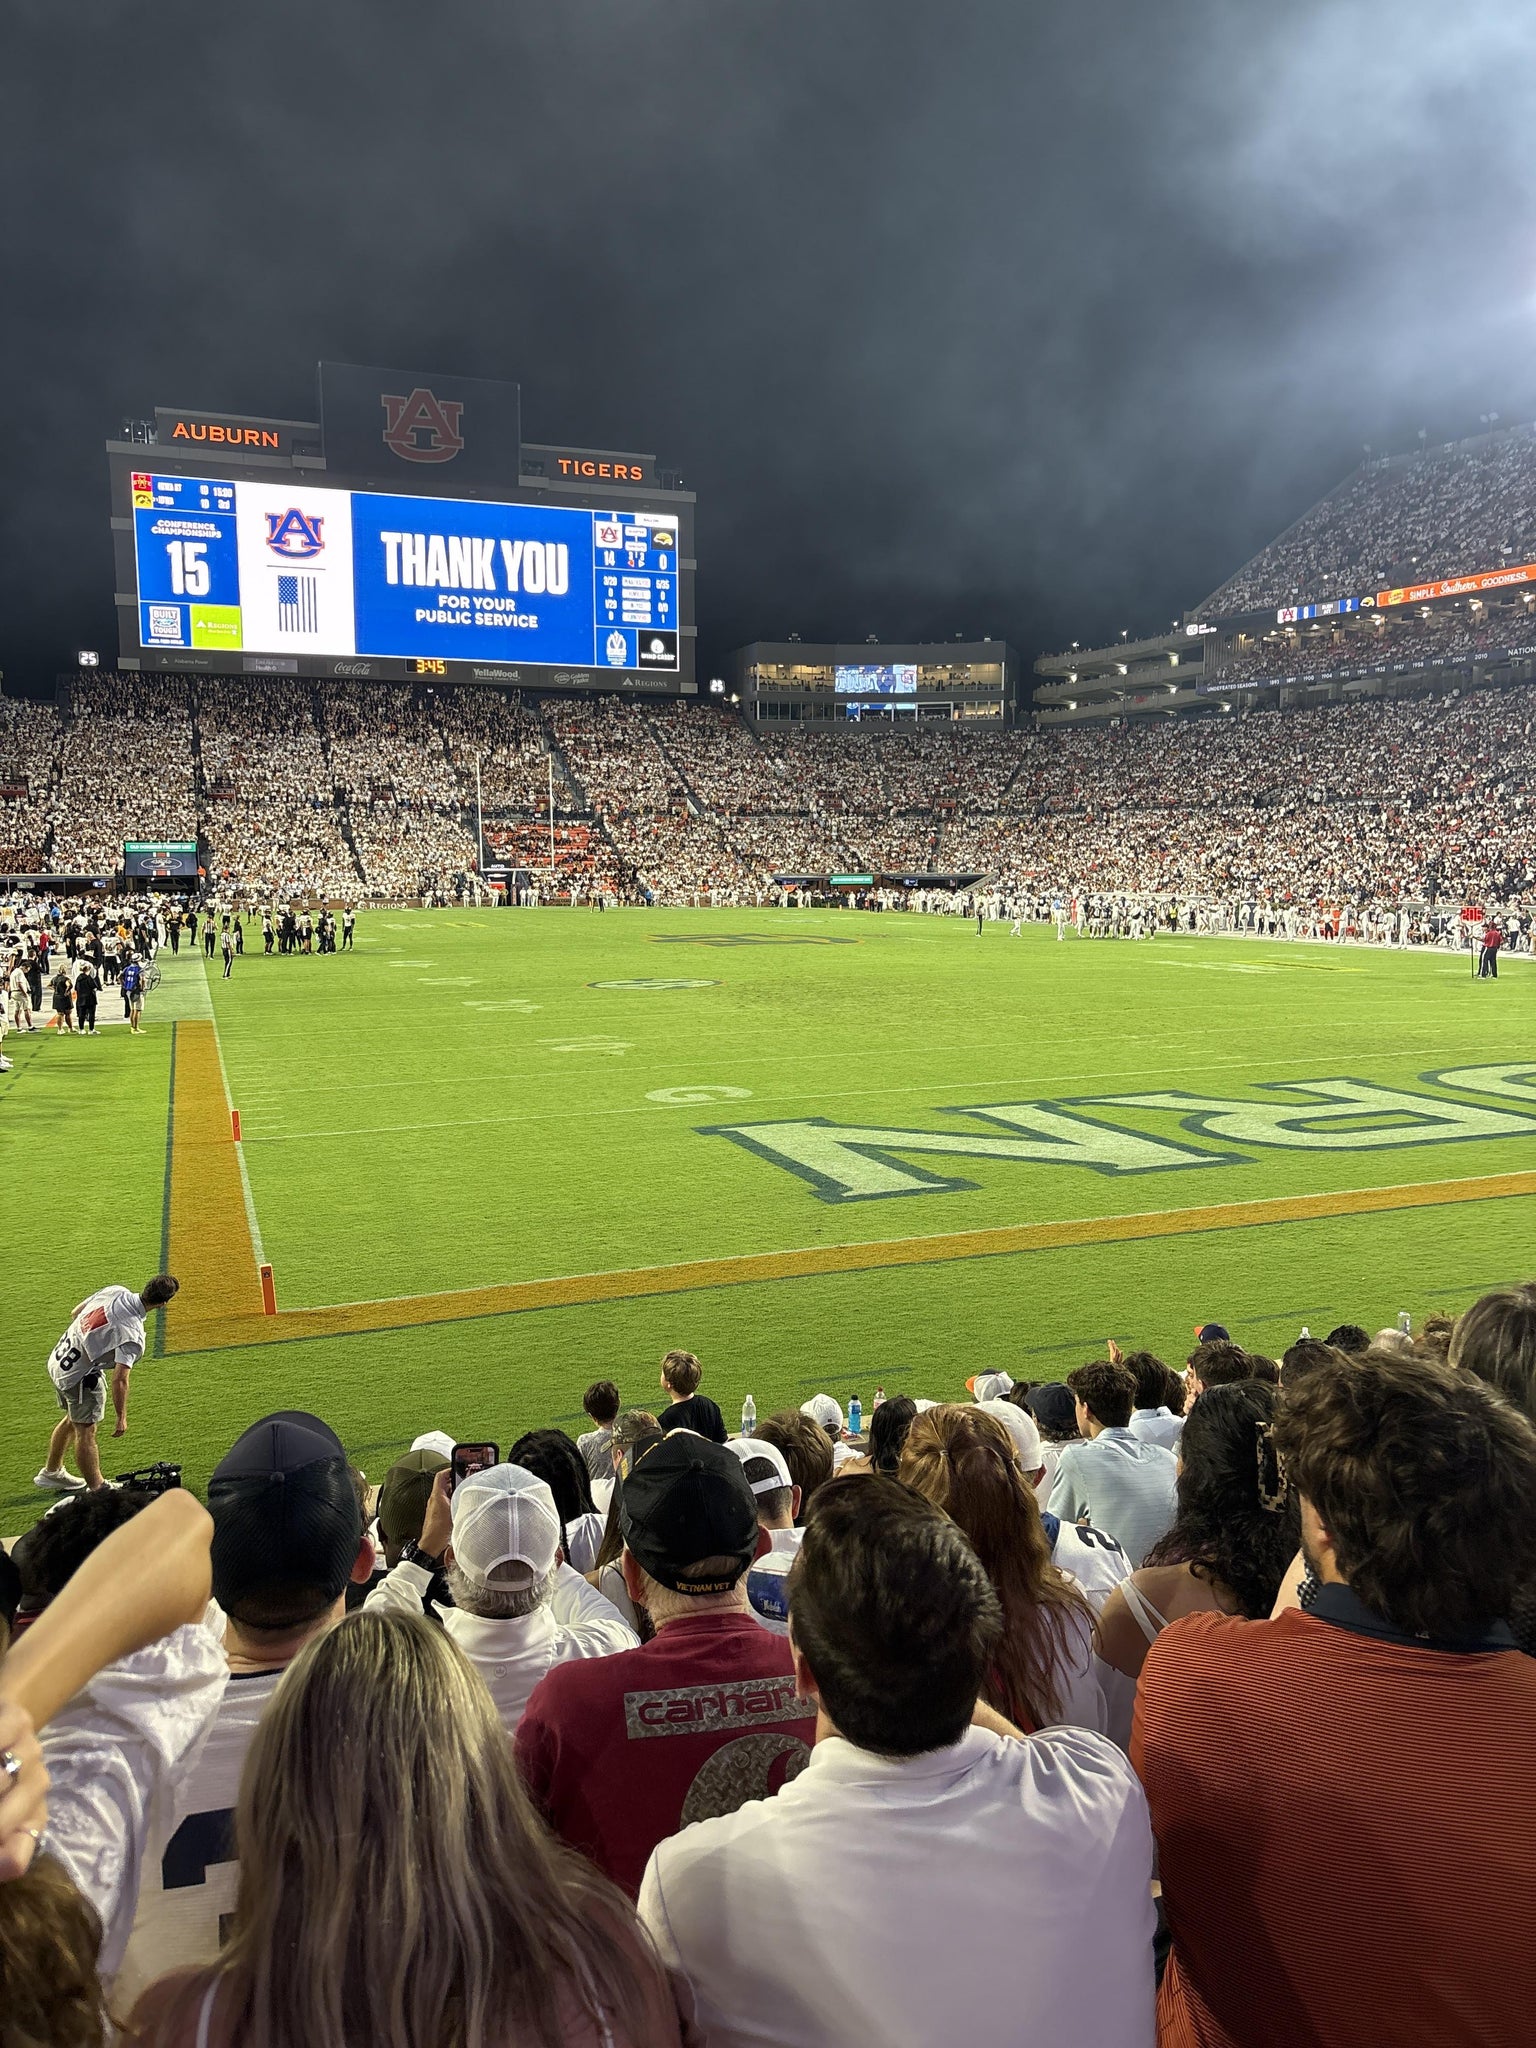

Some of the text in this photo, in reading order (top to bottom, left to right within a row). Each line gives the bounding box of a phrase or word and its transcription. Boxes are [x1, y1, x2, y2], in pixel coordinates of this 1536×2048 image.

[172, 423, 279, 448] AUBURN
[557, 458, 644, 481] TIGERS
[151, 526, 222, 538] CHAMPIONSHIPS
[157, 519, 215, 531] CONFERENCE
[380, 531, 569, 595] THANK YOU
[603, 550, 615, 566] 14
[659, 553, 667, 570] 0
[166, 541, 210, 596] 15
[438, 595, 516, 612] FOR YOUR
[153, 609, 177, 619] BUILT
[416, 609, 538, 628] PUBLIC SERVICE
[154, 626, 178, 634] TOUGH
[640, 652, 657, 660] WIND
[416, 658, 445, 674] 3:45
[1206, 683, 1237, 692] UNDEFEATED
[1236, 681, 1258, 690] SEASONS
[676, 1581, 730, 1592] VIETNAM VET
